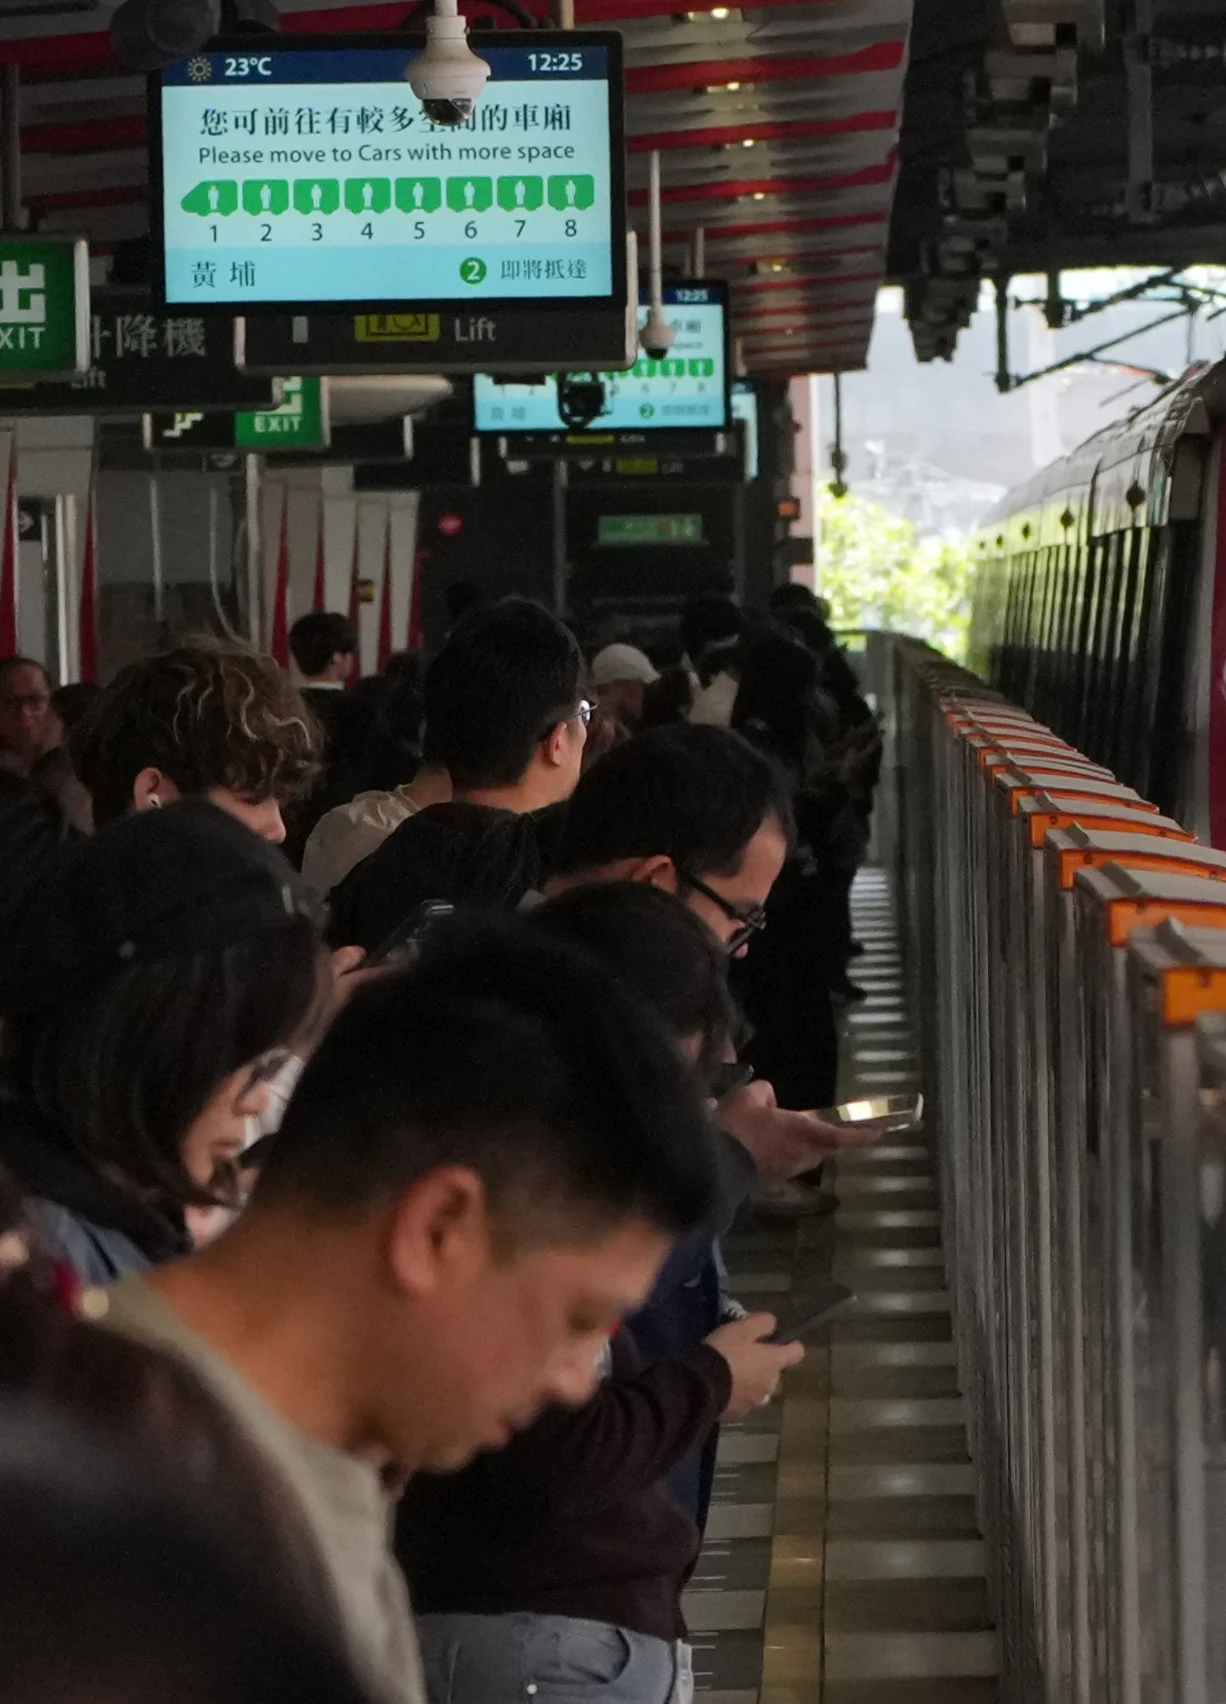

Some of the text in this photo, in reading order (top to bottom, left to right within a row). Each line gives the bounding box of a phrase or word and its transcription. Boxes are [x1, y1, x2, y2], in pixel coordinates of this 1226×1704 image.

[225, 57, 272, 76] 23°C
[528, 54, 582, 72] 12:25
[199, 143, 575, 164] Please move to Cars with more space
[209, 219, 577, 243] 1 2 3 4 5 6 7 8
[466, 260, 481, 280] 2
[500, 259, 587, 280] 即將抵達
[0, 327, 46, 349] XIT
[454, 316, 496, 341] Lift
[254, 415, 303, 433] EXIT
